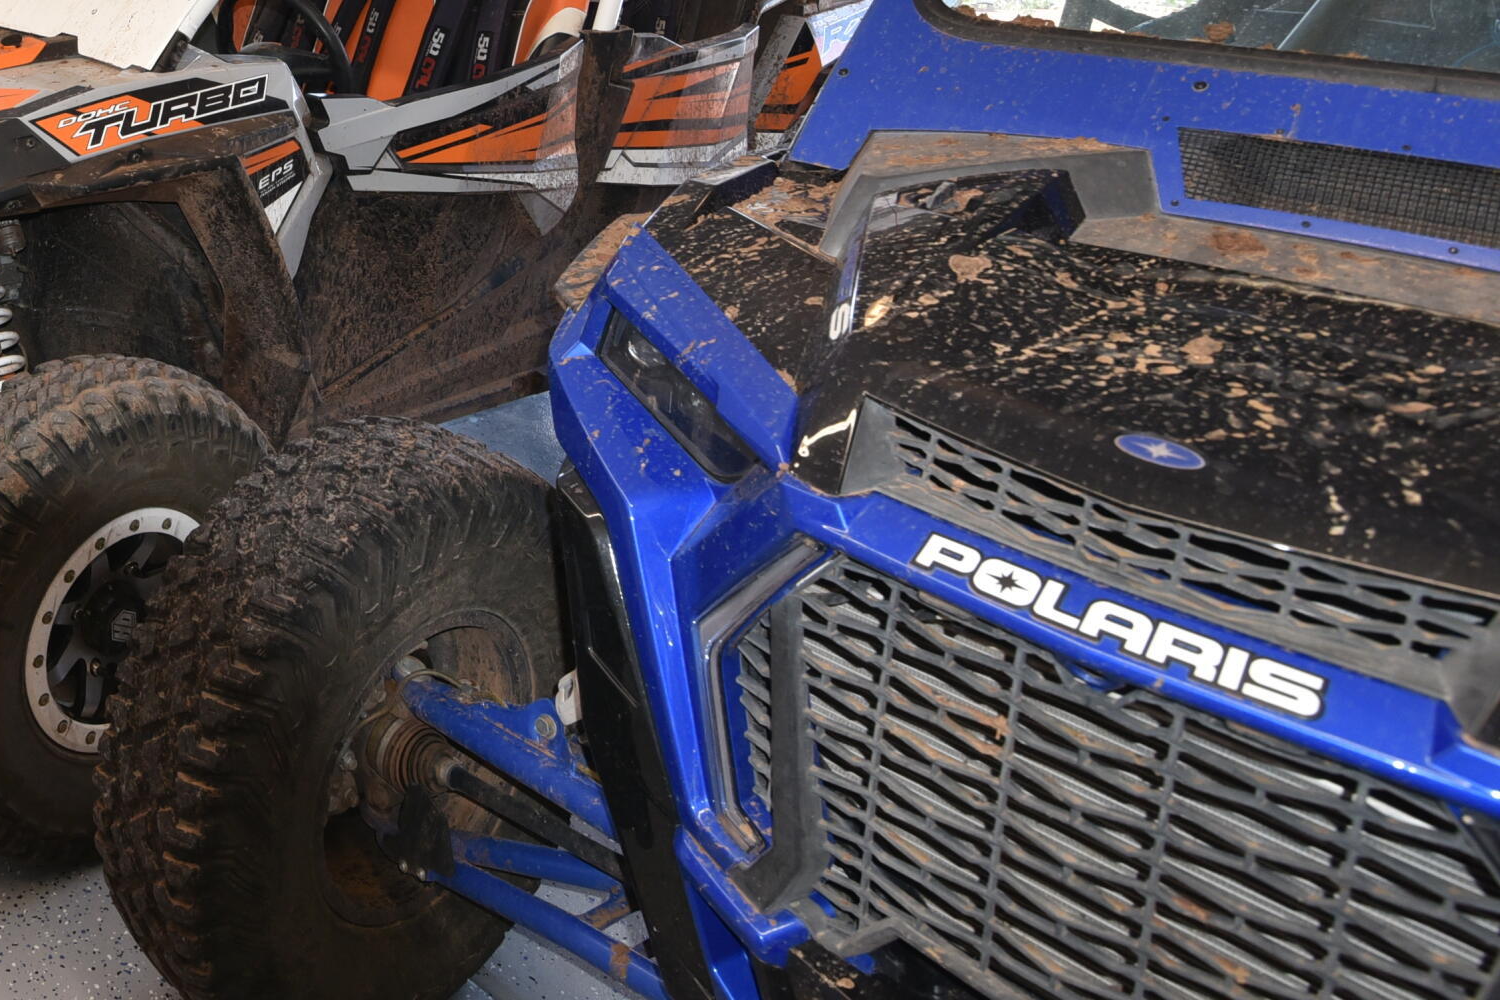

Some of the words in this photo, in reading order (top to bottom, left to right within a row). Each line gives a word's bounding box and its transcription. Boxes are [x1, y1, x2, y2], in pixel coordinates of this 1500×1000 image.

[57, 100, 131, 129] DOHC
[71, 74, 269, 150] TURBO
[259, 159, 294, 190] EPS
[916, 535, 1327, 718] POLARIS
